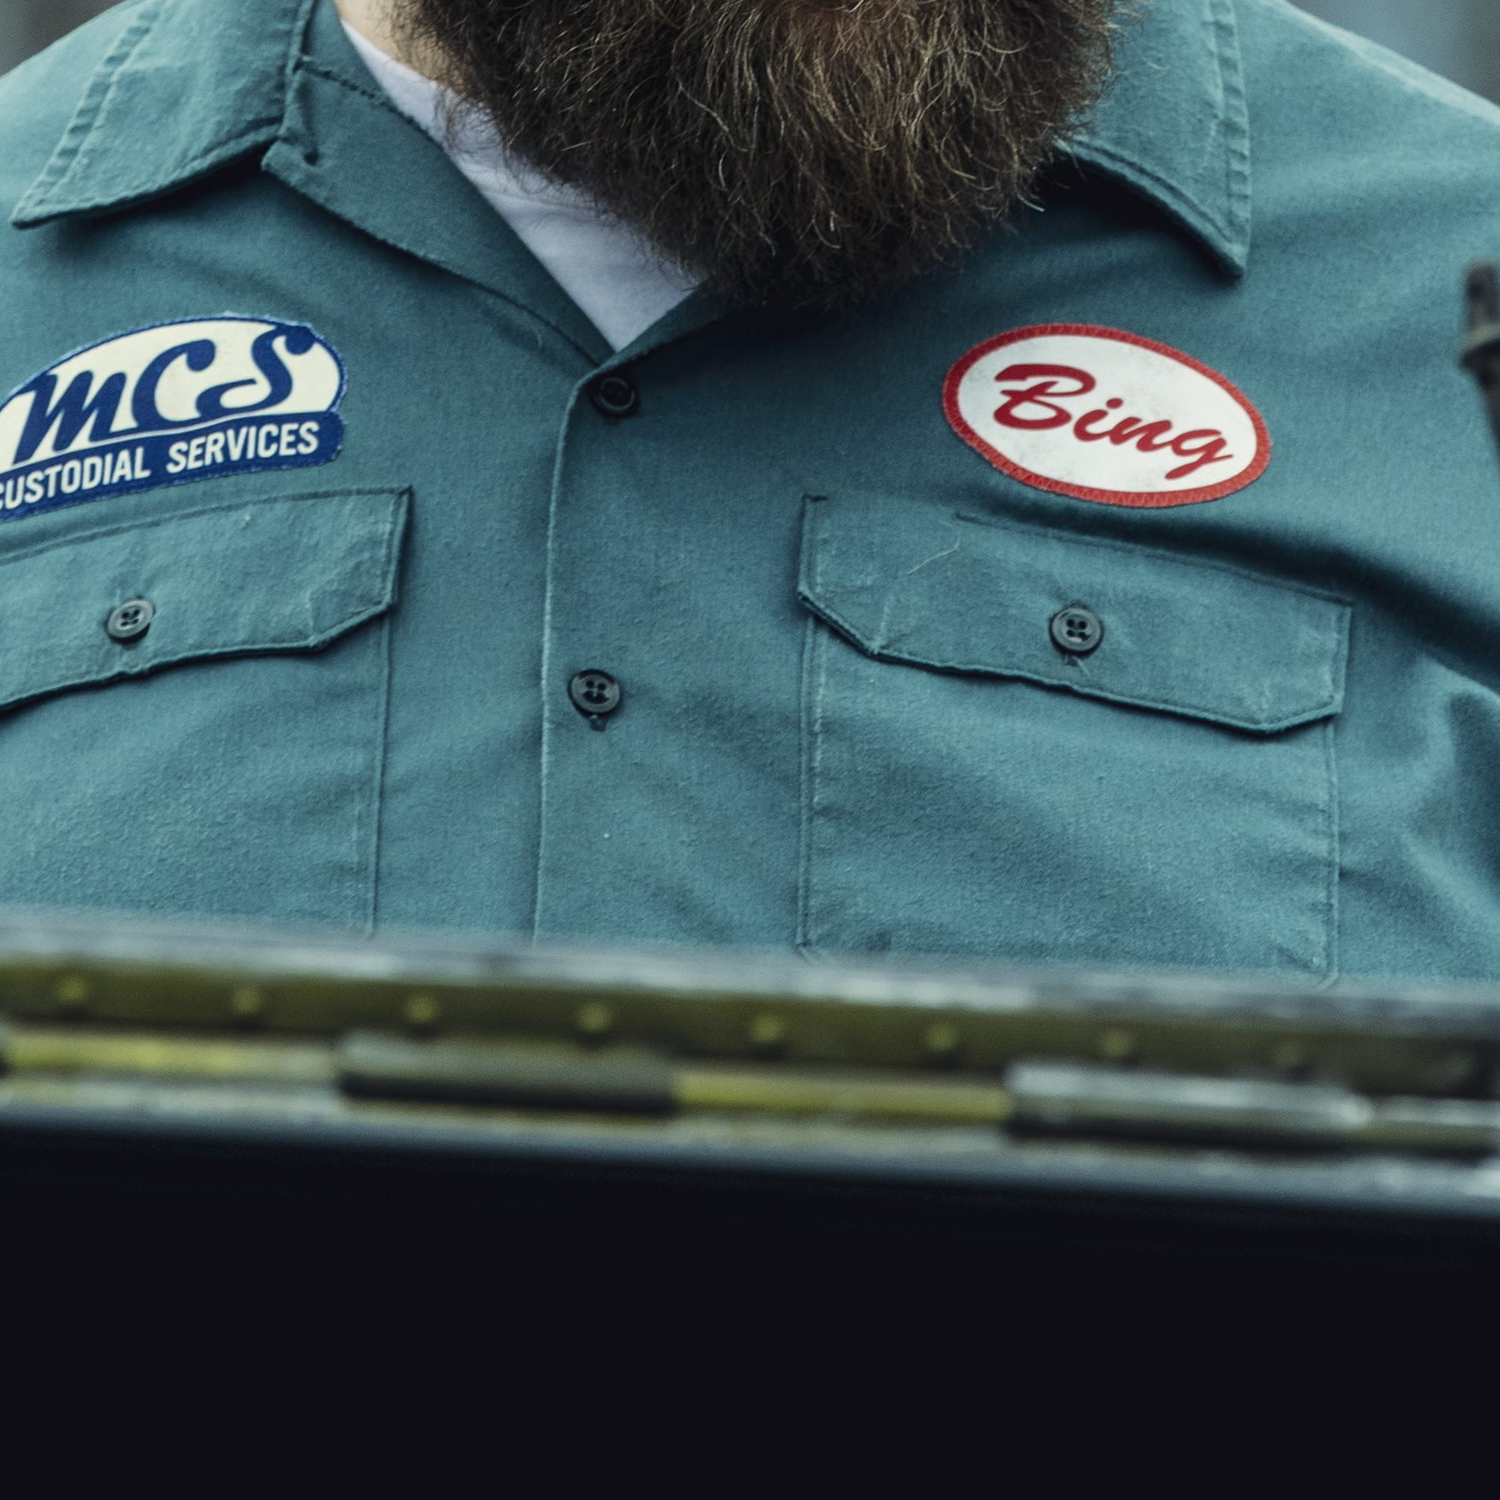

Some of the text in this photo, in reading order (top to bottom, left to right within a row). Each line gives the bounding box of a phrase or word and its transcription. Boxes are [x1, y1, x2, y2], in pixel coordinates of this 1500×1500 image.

[13, 324, 316, 466] MCS
[166, 420, 320, 474] SERVICES
[993, 363, 1234, 481] Bing
